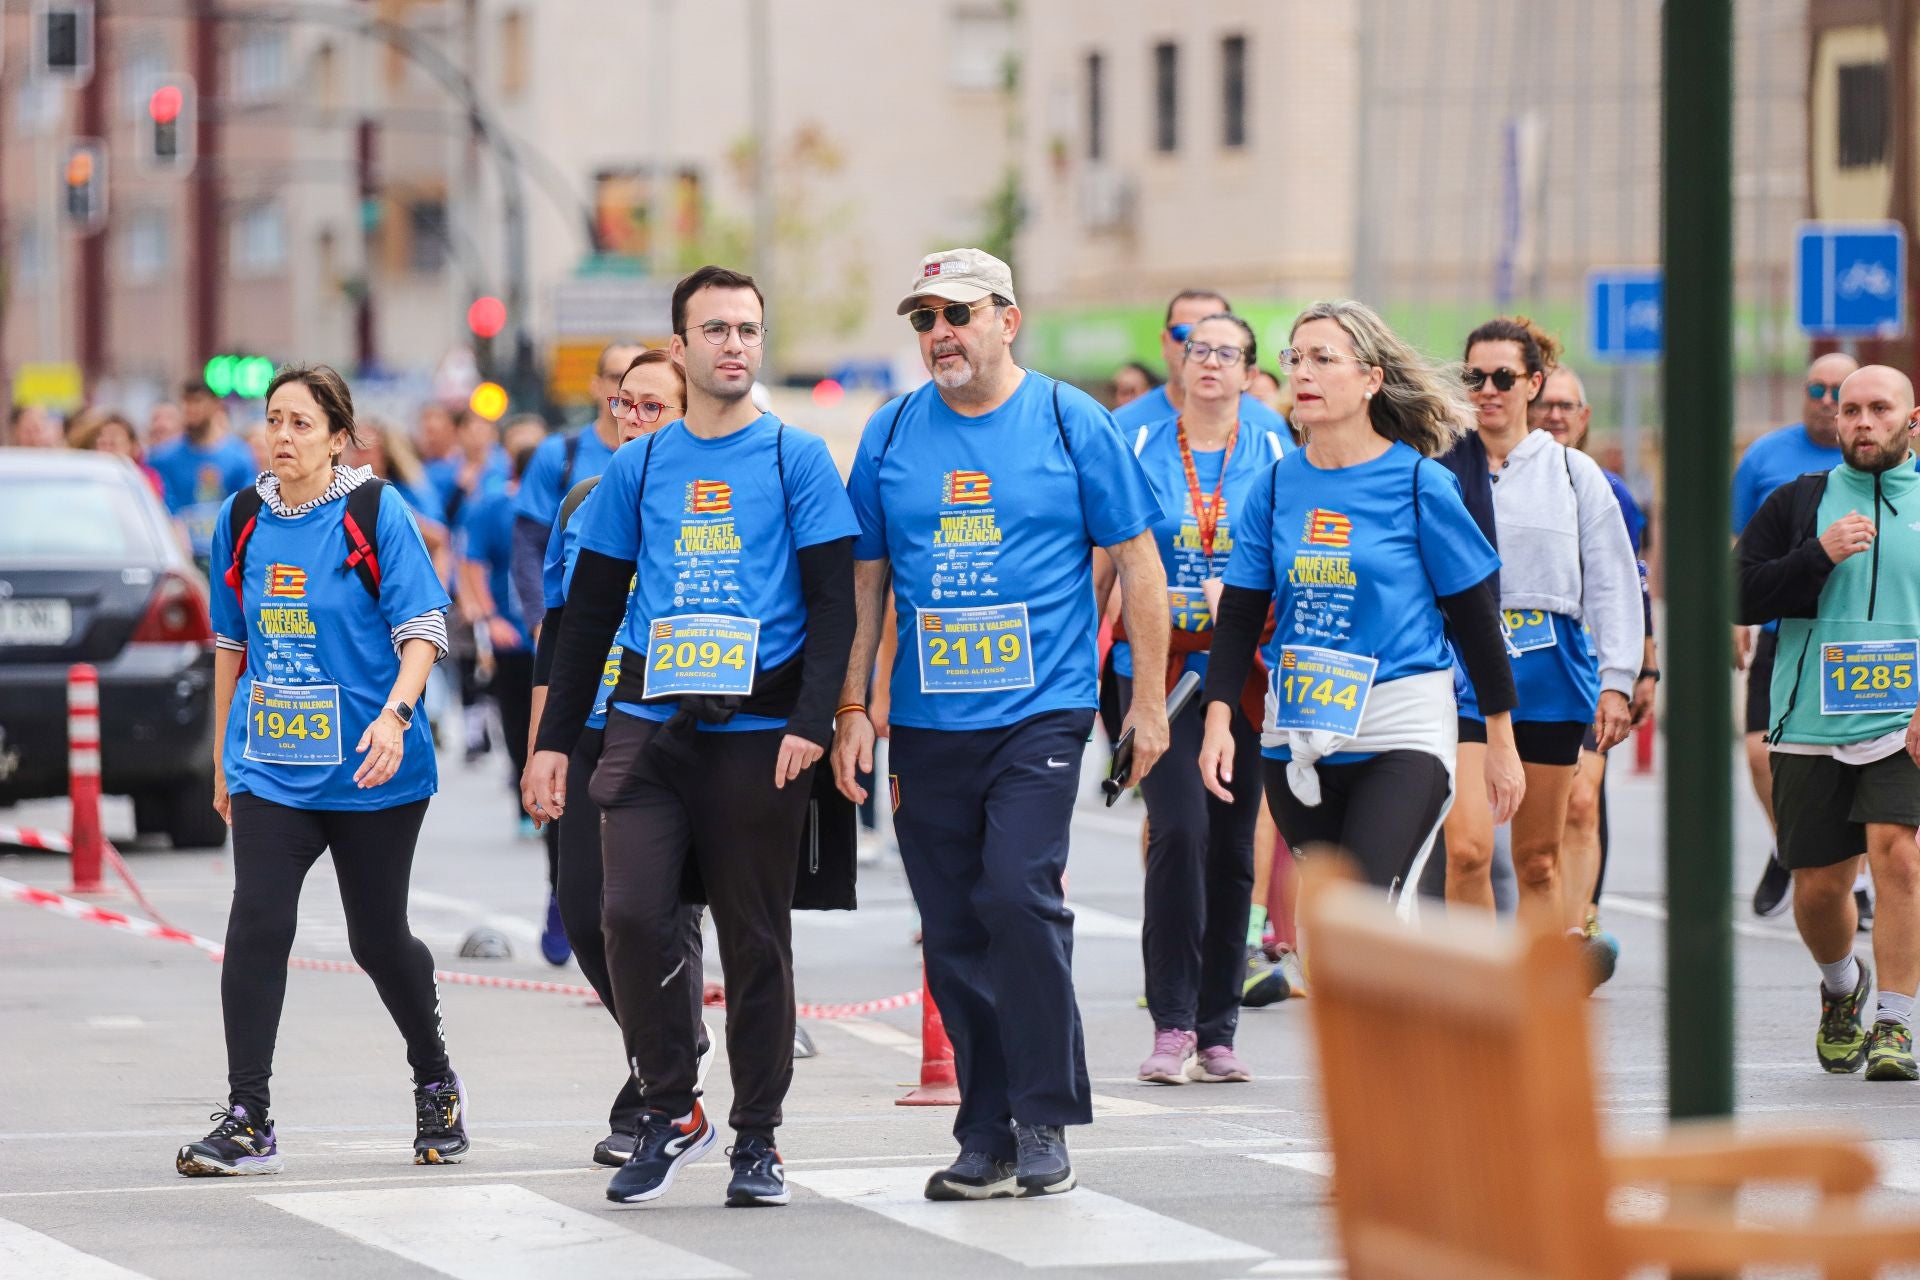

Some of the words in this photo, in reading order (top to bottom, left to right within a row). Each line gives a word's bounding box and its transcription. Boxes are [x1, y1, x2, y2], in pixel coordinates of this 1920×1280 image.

[940, 513, 995, 531] MUÉVETE
[681, 522, 735, 540] MUÉVETE
[933, 530, 942, 544] X
[944, 528, 1003, 543] VALENCIA
[674, 539, 683, 553] X
[685, 536, 742, 552] VALENCIA
[1294, 554, 1350, 572] MUÉVETE
[1287, 569, 1296, 583] X
[1297, 569, 1357, 586] VALENCIA
[260, 606, 310, 622] MUÉVETE
[265, 621, 317, 635] VALENCIA
[675, 628, 707, 638] MUÉVETE
[709, 629, 715, 637] X
[716, 629, 752, 641] VALENCIA
[945, 622, 978, 633] MUÉVETE
[979, 622, 985, 632] X
[986, 619, 1023, 631] VALENCIA
[654, 641, 746, 671] 2094
[928, 633, 1021, 666] 2119
[971, 666, 1006, 674] ALFONSO
[1332, 666, 1368, 682] VALENCIA
[1830, 664, 1913, 691] 1285
[1284, 675, 1358, 711] 1744
[265, 698, 292, 710] MUÉVETE
[292, 700, 298, 710] X
[300, 700, 334, 710] VALENCIA
[254, 710, 332, 740] 1943
